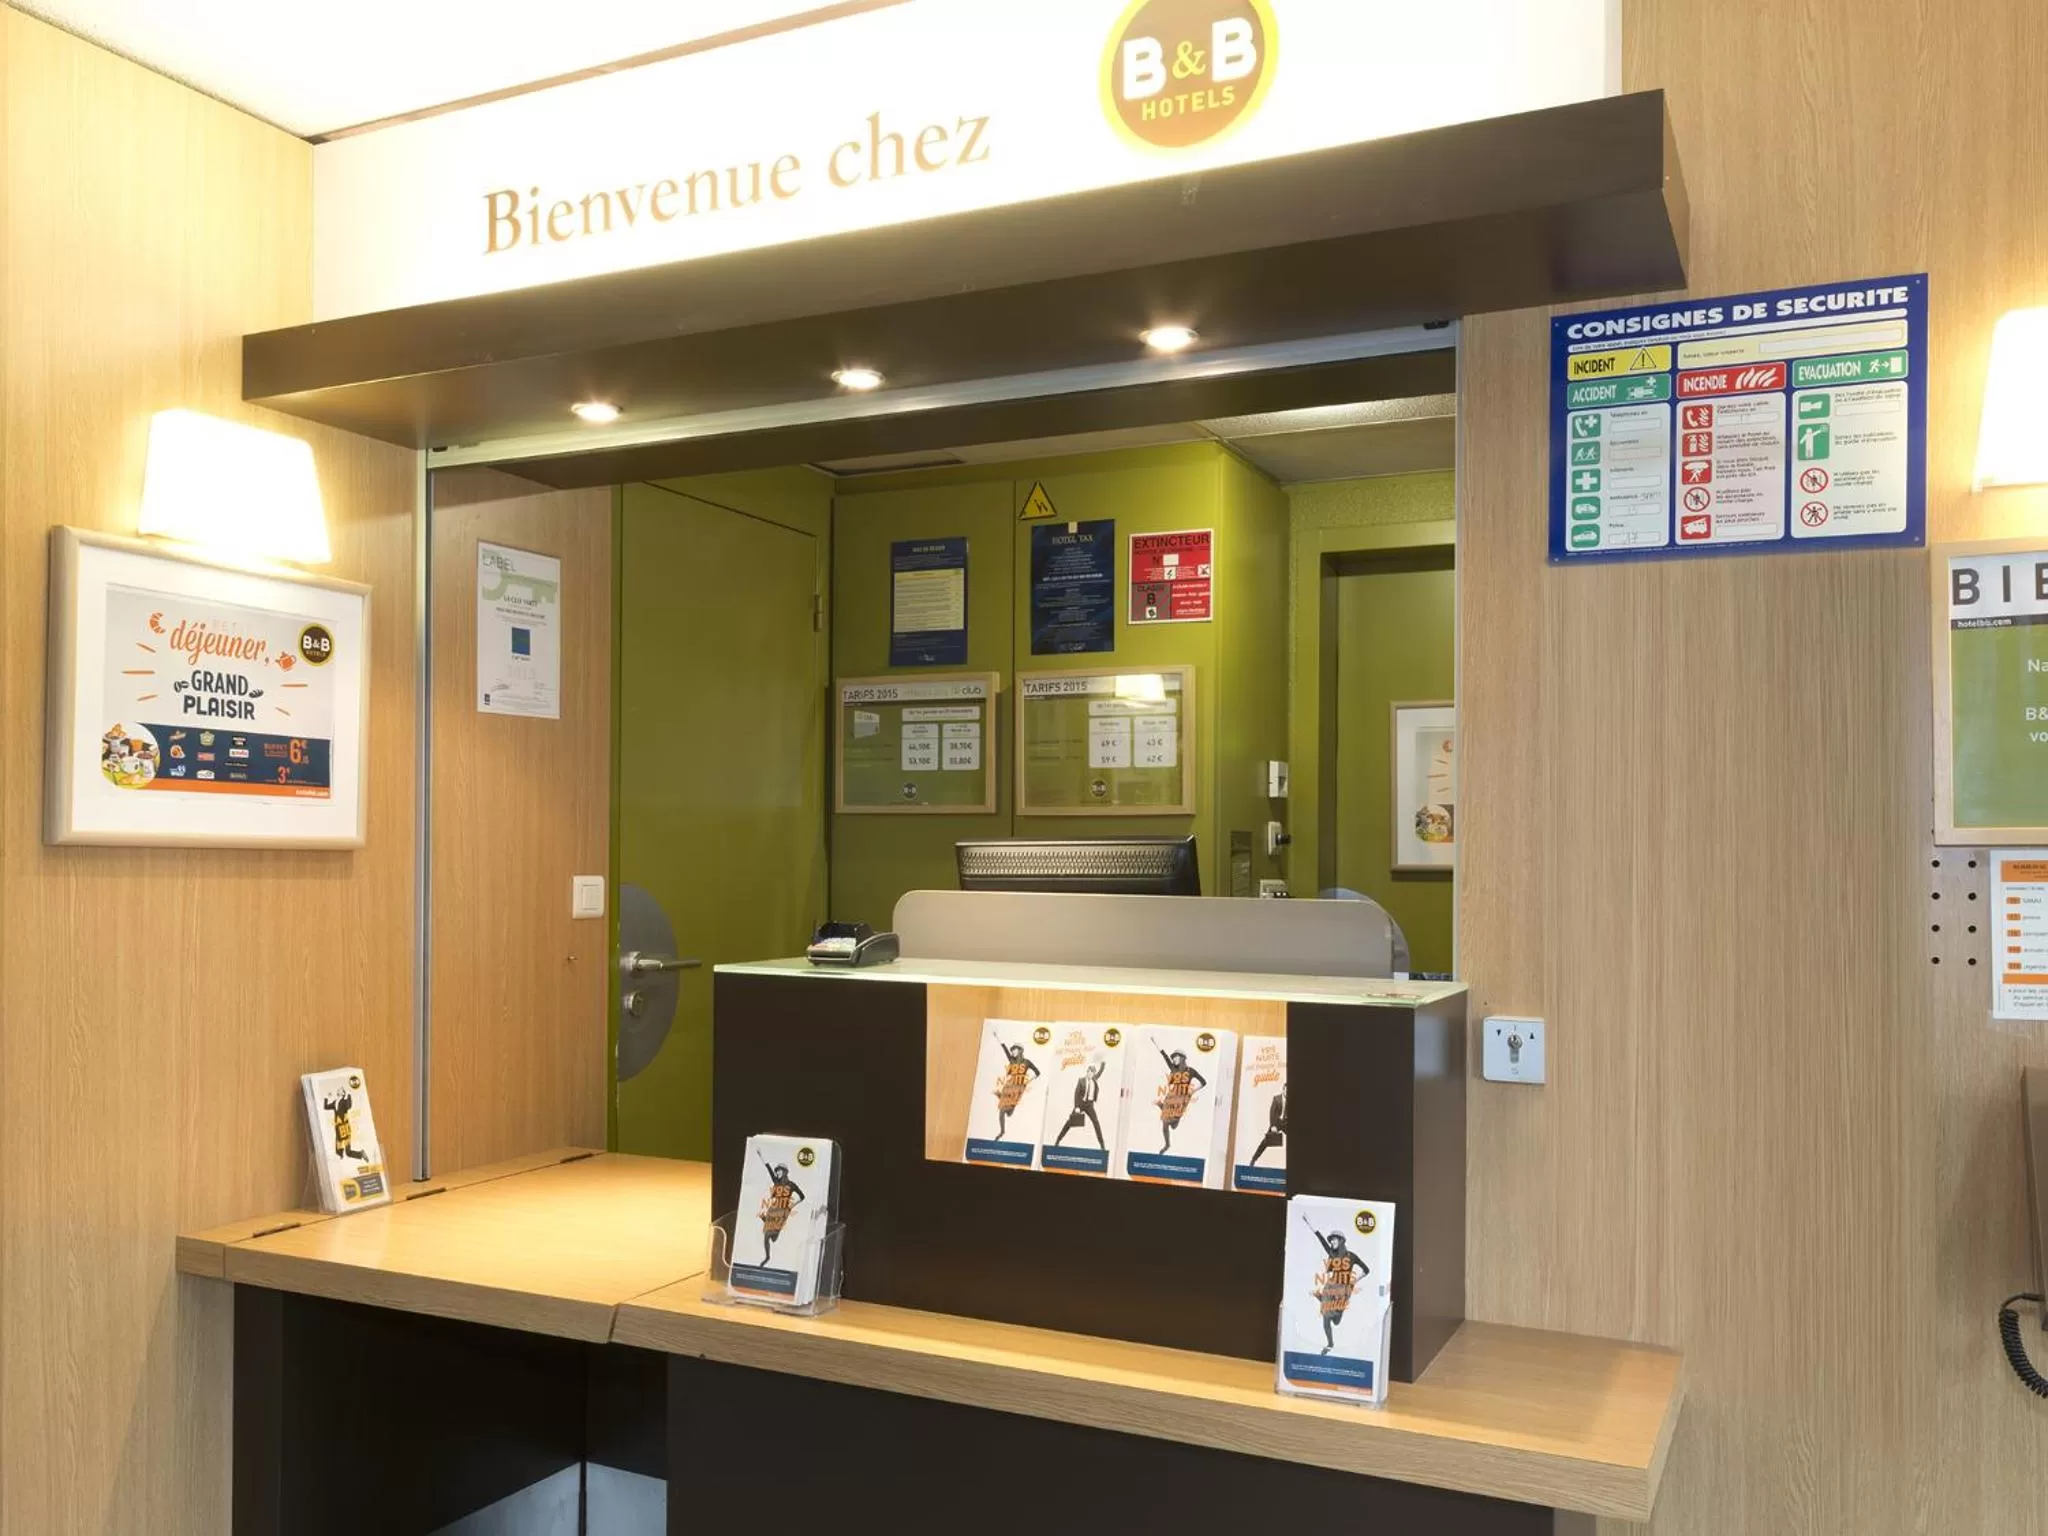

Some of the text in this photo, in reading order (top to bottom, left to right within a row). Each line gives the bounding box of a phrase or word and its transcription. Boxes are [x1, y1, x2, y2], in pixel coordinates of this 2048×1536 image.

[1123, 17, 1257, 101] B&B
[1142, 85, 1235, 121] HOTELS
[483, 111, 991, 256] Bienvenue chez
[1568, 286, 1908, 339] CONSIGNES DE SECURITE
[1574, 358, 1615, 375] INCIDENT
[1798, 360, 1861, 381] EVACUATION
[1572, 384, 1617, 402] ACCIDENT
[1683, 375, 1727, 393] INCENDIE
[1134, 534, 1210, 549] EXTINCTEUR
[1957, 618, 2012, 628] hotelbb.com
[170, 620, 269, 667] déjeuner,
[303, 635, 330, 652] B&B
[191, 670, 248, 696] GRAND
[1025, 680, 1087, 693] TARIFS 2015
[844, 688, 875, 701] TARIFS
[877, 687, 898, 700] 2015
[183, 695, 255, 720] PLAISIR
[1356, 1216, 1374, 1227] B&B
